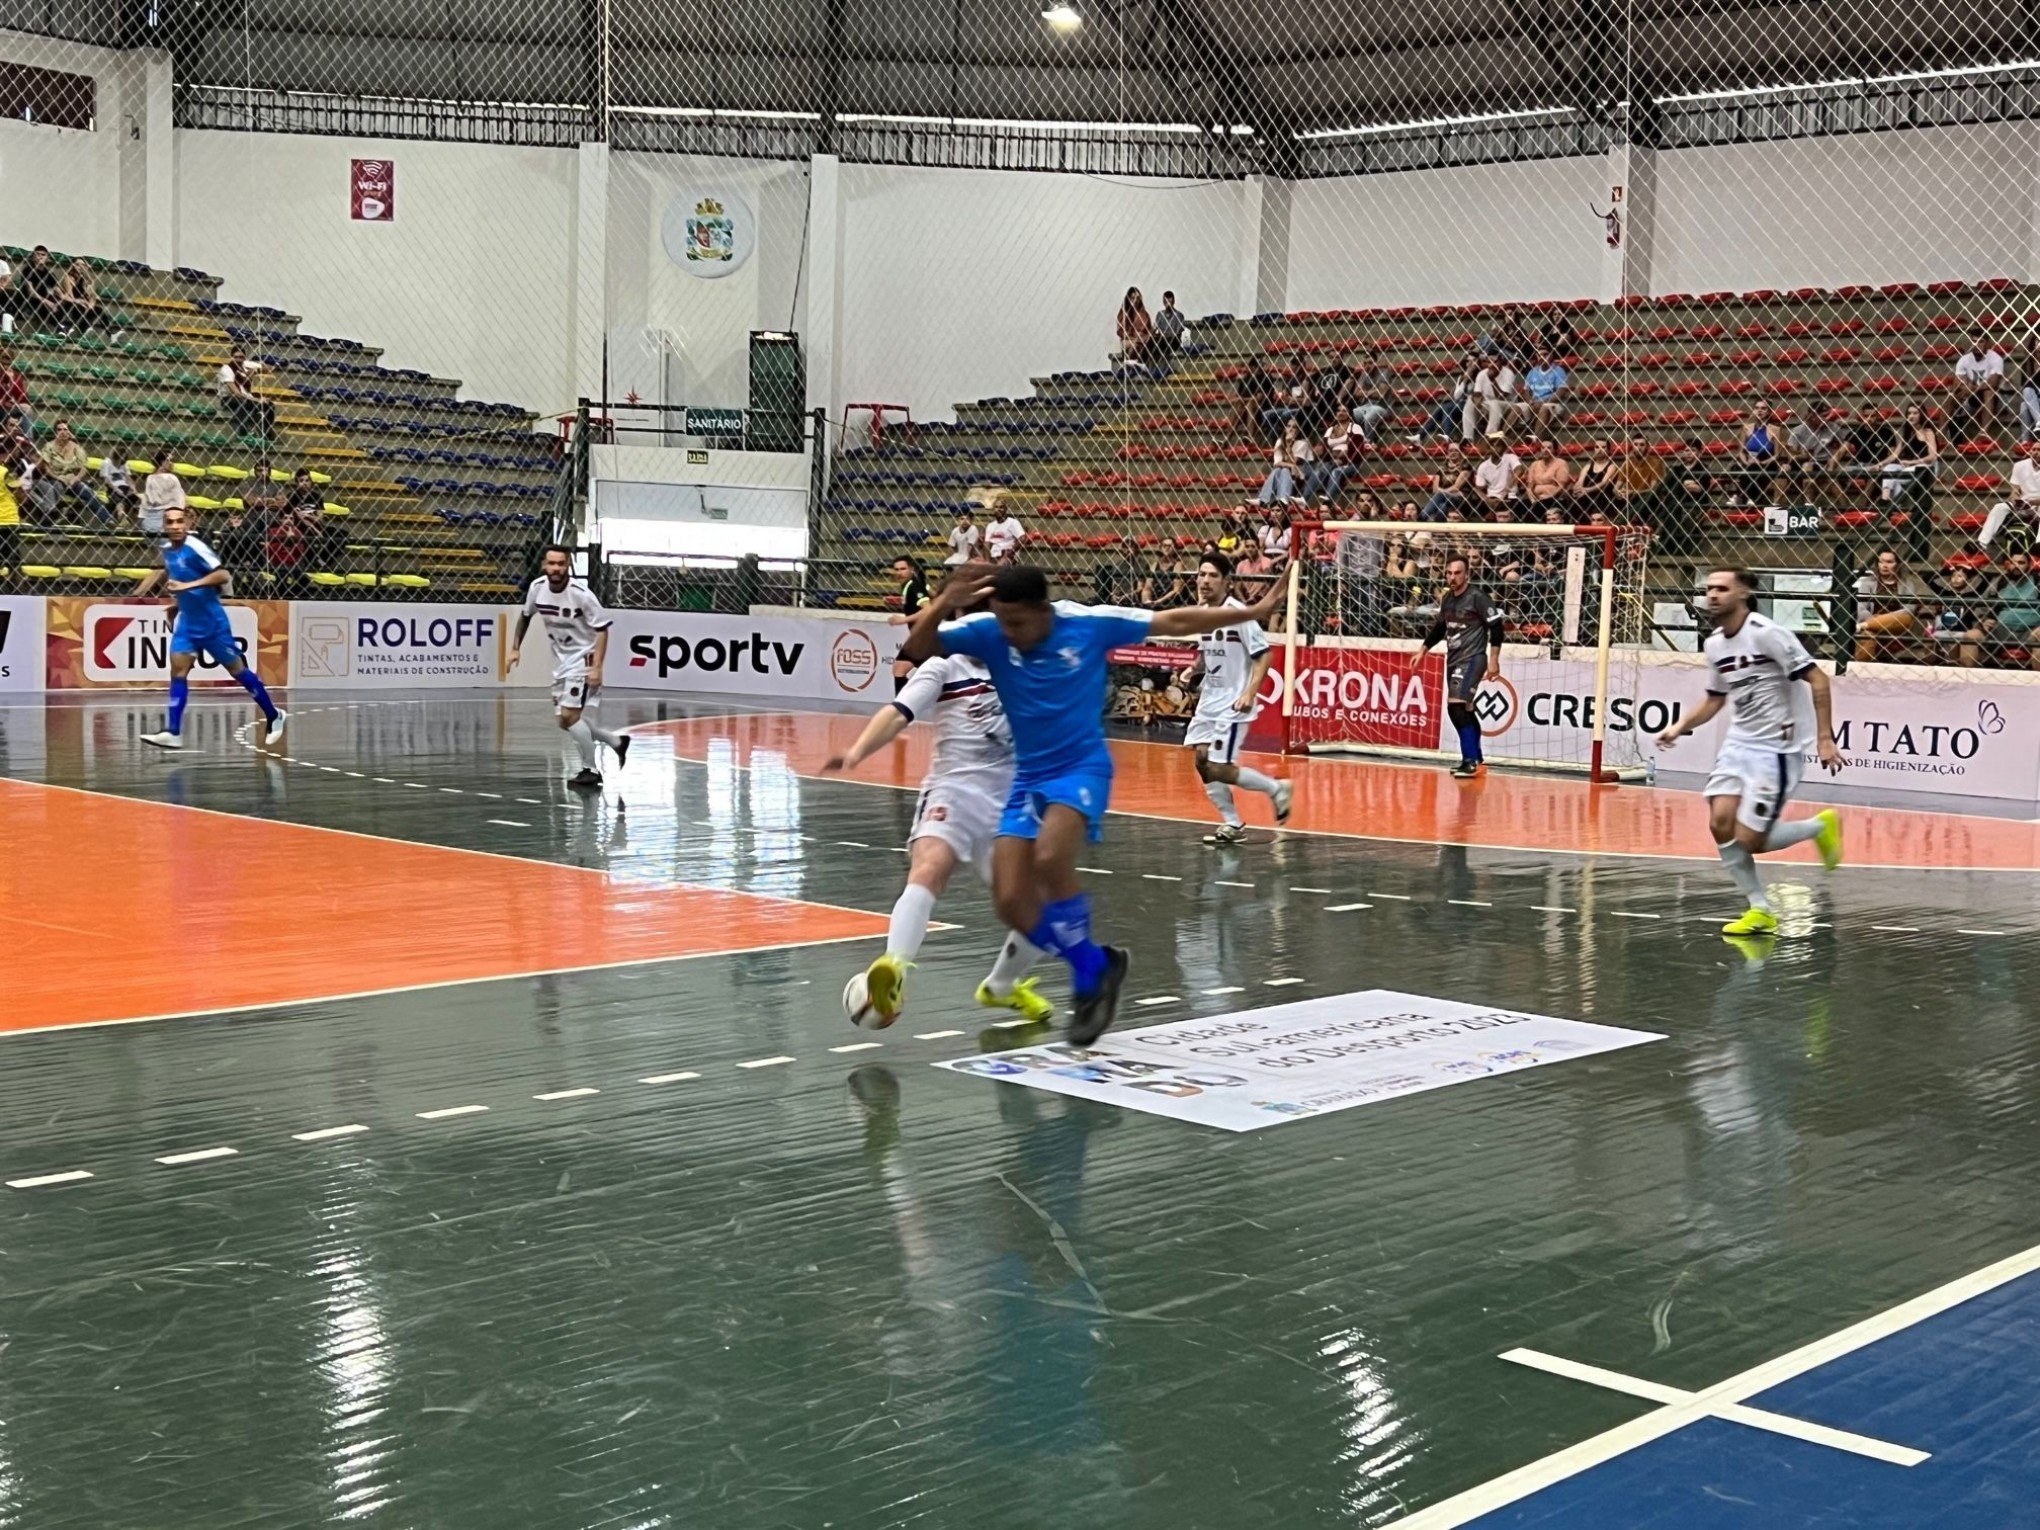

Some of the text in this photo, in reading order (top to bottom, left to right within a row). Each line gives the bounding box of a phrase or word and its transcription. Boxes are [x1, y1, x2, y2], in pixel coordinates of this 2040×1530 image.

[687, 416, 741, 429] SANITÁRIO
[1789, 516, 1818, 528] BAR
[138, 619, 174, 633] TIN
[357, 618, 494, 647] ROLOFF
[357, 654, 478, 662] TINTAS, ACABAMENTOS E
[630, 633, 804, 678] sportv
[357, 665, 489, 675] MATERIAIS DE CONSTRUÇÃO
[1293, 668, 1428, 714] KRONA
[1293, 706, 1329, 719] UBOS
[1335, 709, 1344, 720] E
[1527, 692, 1694, 736] CRESOL
[1864, 721, 1979, 759] TATO
[1855, 758, 1870, 768] DE
[1873, 759, 1965, 776] HIGIENIZAÇÃO
[1135, 1022, 1268, 1046] Cidade
[1190, 1013, 1433, 1057] Sul-americana
[1257, 1055, 1315, 1069] do
[1298, 1027, 1461, 1059] Desporto
